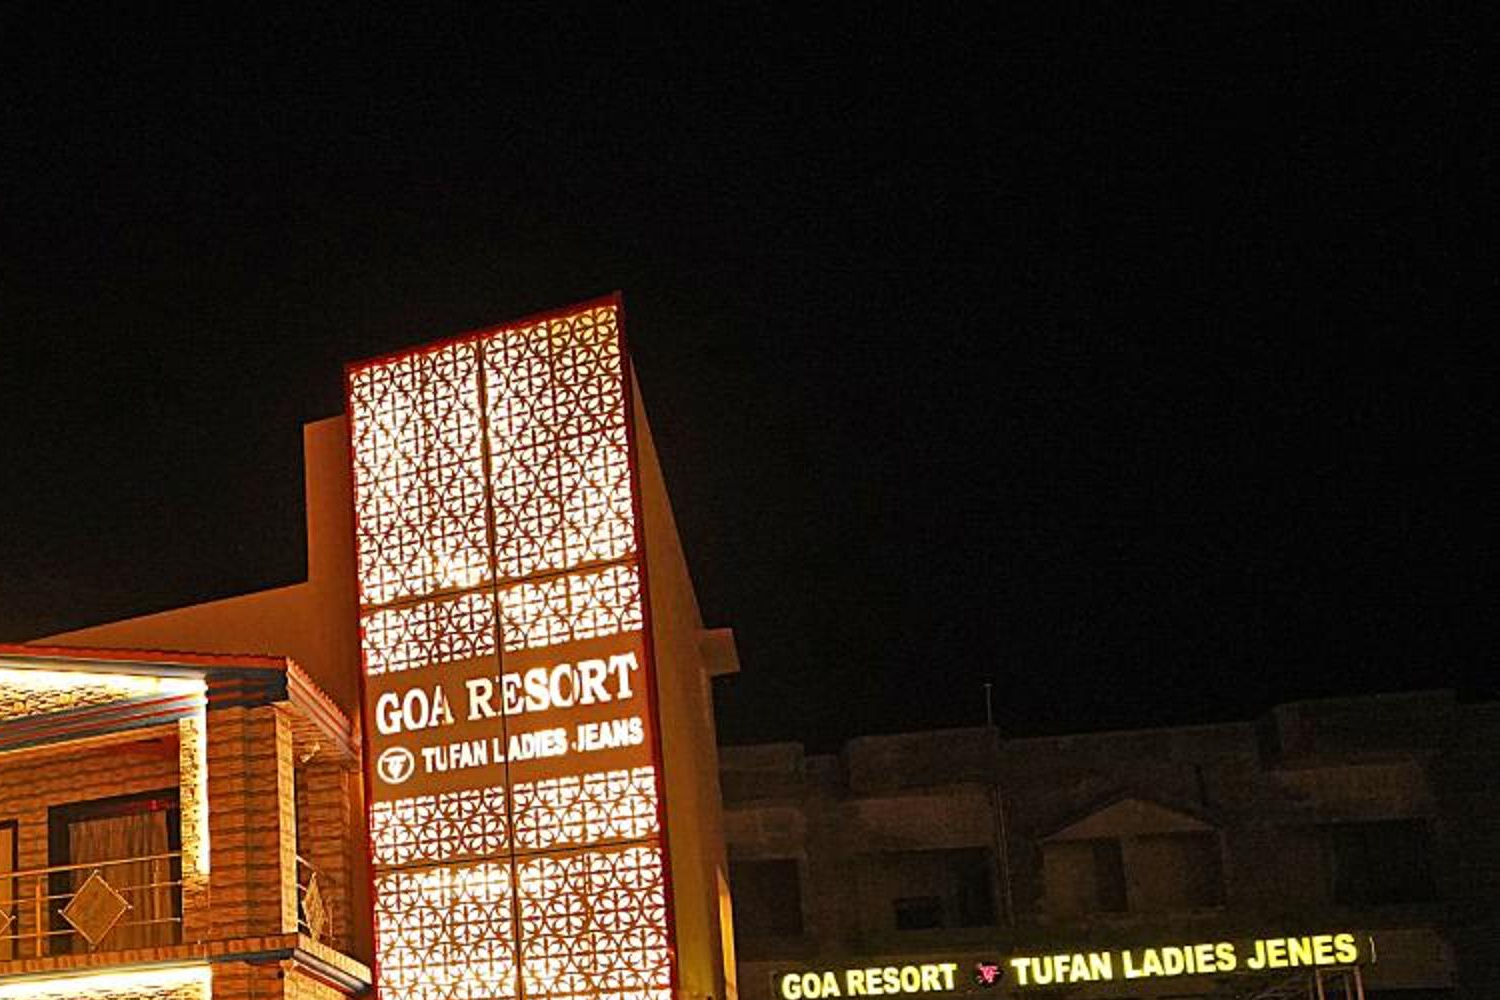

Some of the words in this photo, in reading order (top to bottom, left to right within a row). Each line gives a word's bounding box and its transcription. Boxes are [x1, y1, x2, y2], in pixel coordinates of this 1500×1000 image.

[375, 684, 454, 736] GOA
[465, 652, 638, 721] RESORT
[422, 739, 488, 774] TUFAN
[493, 727, 568, 763] LADIES
[572, 717, 644, 753] JEANS
[781, 971, 840, 1000] GOA
[847, 963, 957, 997] RESORT
[1011, 951, 1113, 987] TUFAN
[1122, 942, 1238, 979] LADIES
[1246, 933, 1358, 971] JENES
